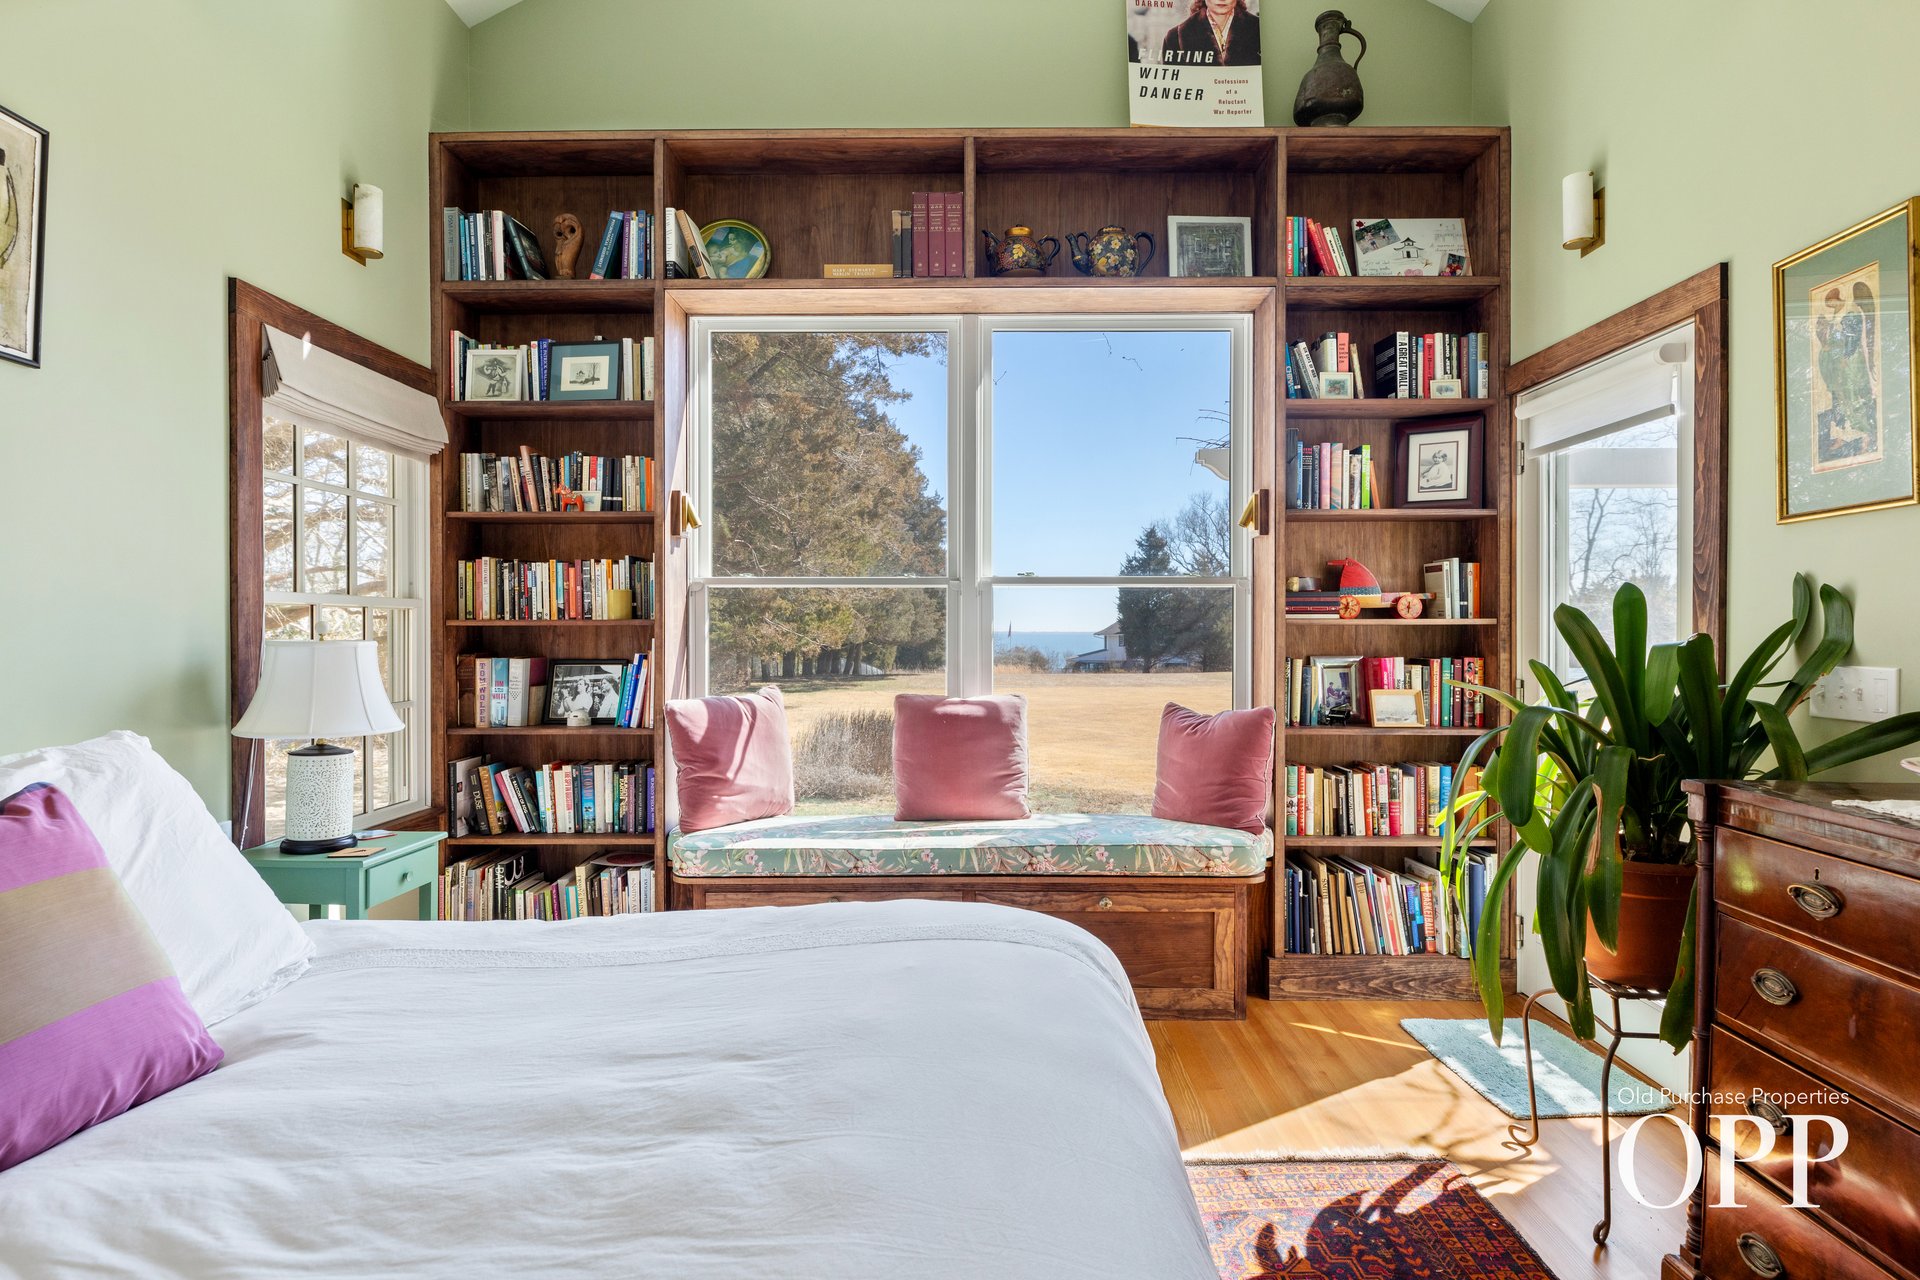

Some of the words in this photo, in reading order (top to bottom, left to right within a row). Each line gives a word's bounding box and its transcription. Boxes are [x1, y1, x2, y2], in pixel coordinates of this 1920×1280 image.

[1138, 48, 1215, 63] FLIRTING
[1139, 67, 1181, 81] WITH
[1139, 85, 1204, 101] DANGER
[1399, 348, 1407, 368] GREAT
[1286, 366, 1294, 387] CHINA
[1399, 370, 1407, 388] WALL
[473, 791, 483, 810] DUSE
[495, 867, 504, 889] BAM
[1423, 893, 1434, 934] BASKETBALL
